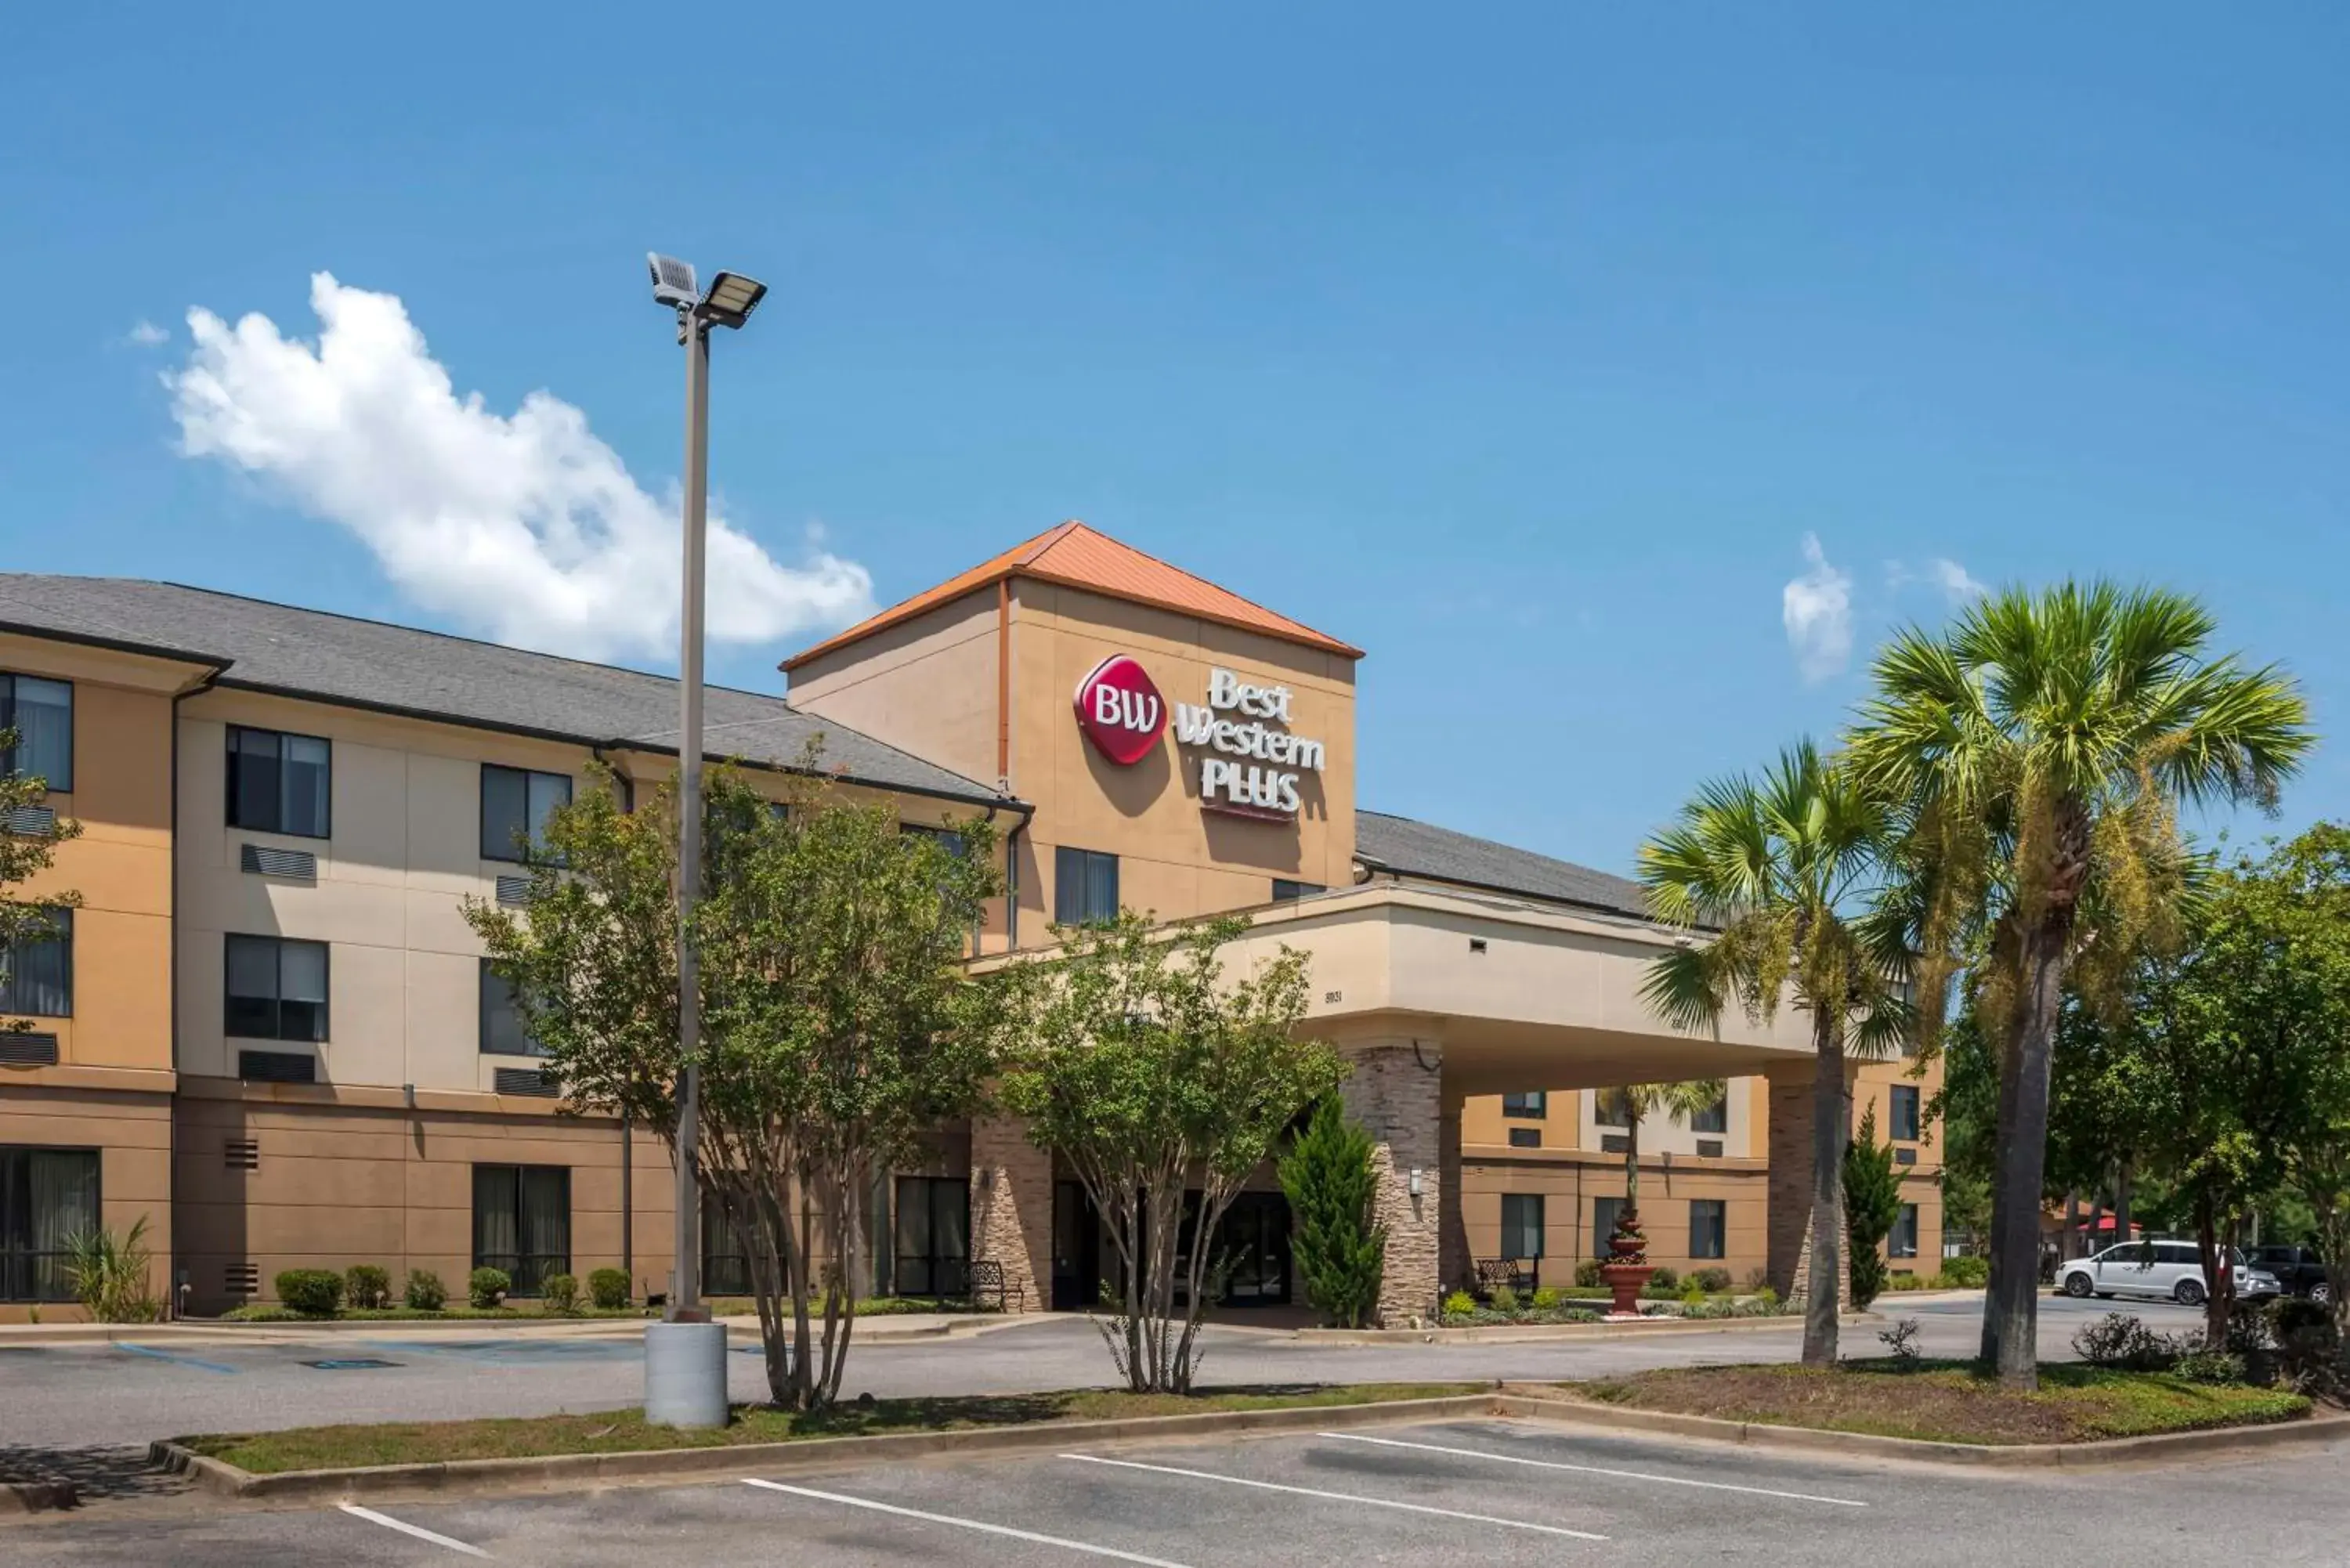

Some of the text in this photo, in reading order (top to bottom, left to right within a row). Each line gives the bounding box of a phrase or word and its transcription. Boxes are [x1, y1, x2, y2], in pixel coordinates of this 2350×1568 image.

[1095, 684, 1159, 733] BW
[1207, 668, 1293, 722] Best
[1173, 703, 1325, 771] Western
[1201, 757, 1300, 811] PLUS
